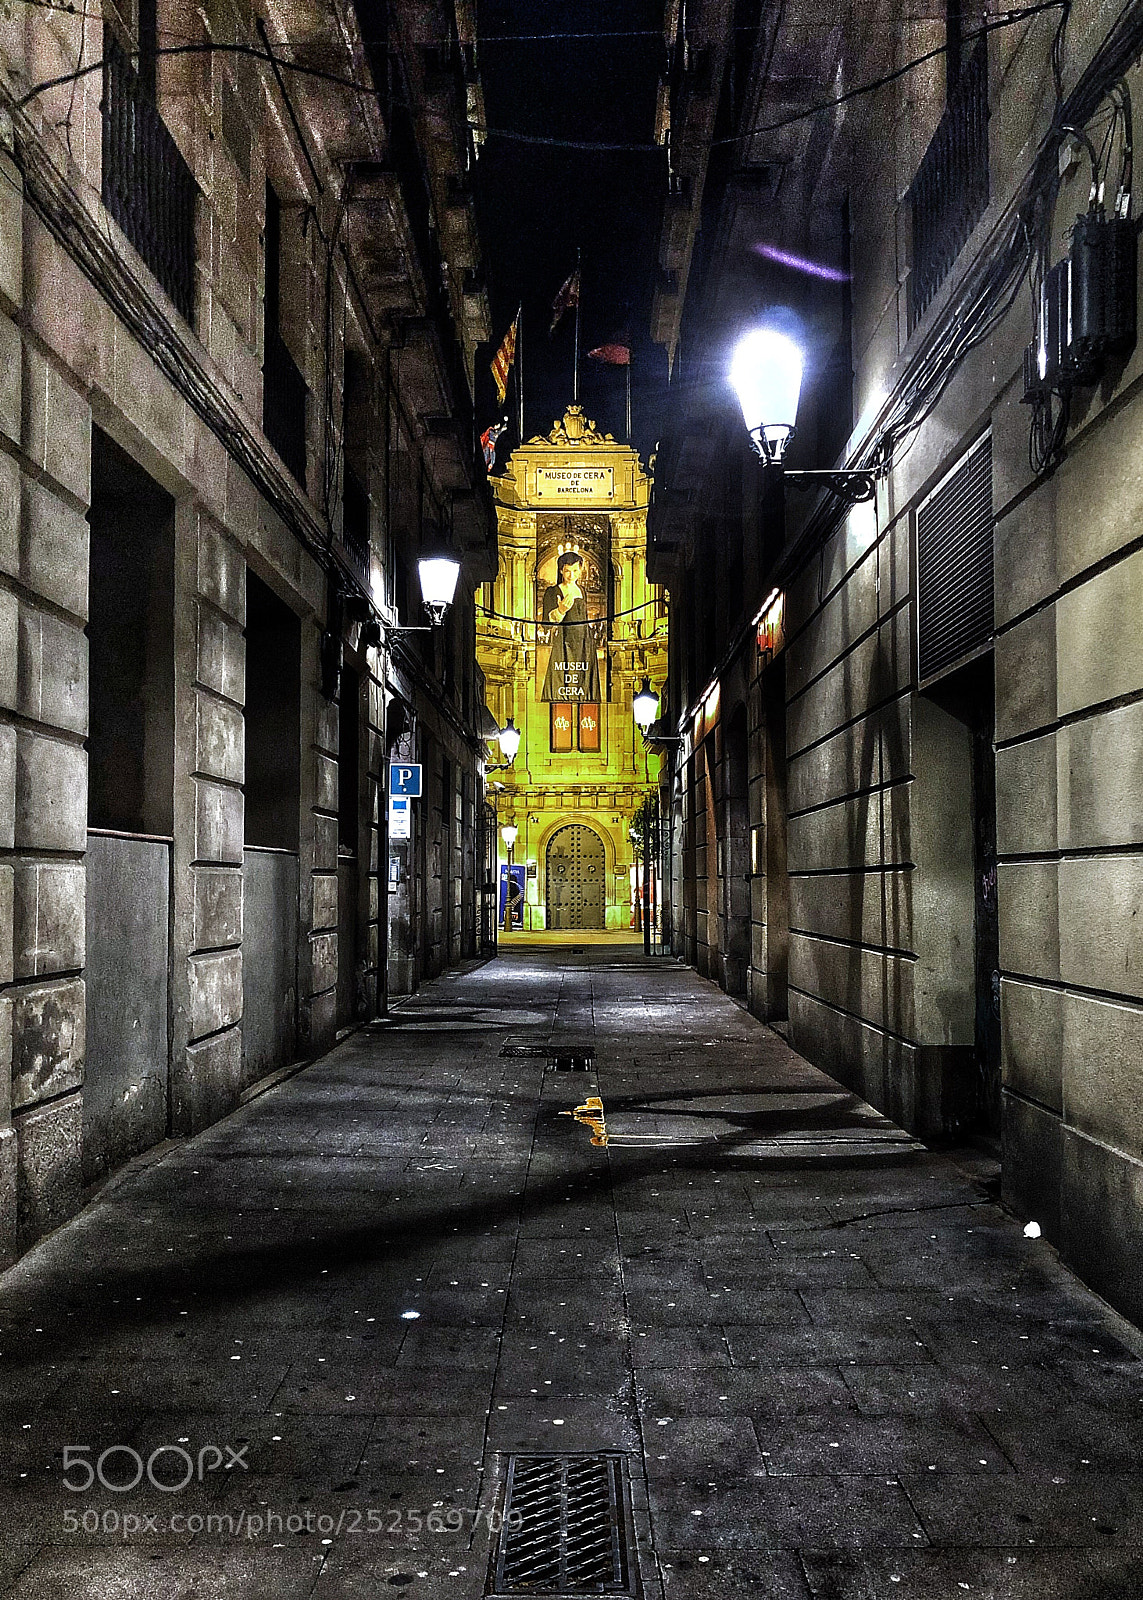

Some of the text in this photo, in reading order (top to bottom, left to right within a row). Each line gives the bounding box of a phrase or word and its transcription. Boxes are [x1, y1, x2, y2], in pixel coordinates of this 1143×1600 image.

[554, 661, 589, 671] MUSEU
[564, 674, 579, 683] DE
[558, 686, 585, 696] CERA
[398, 768, 413, 786] P
